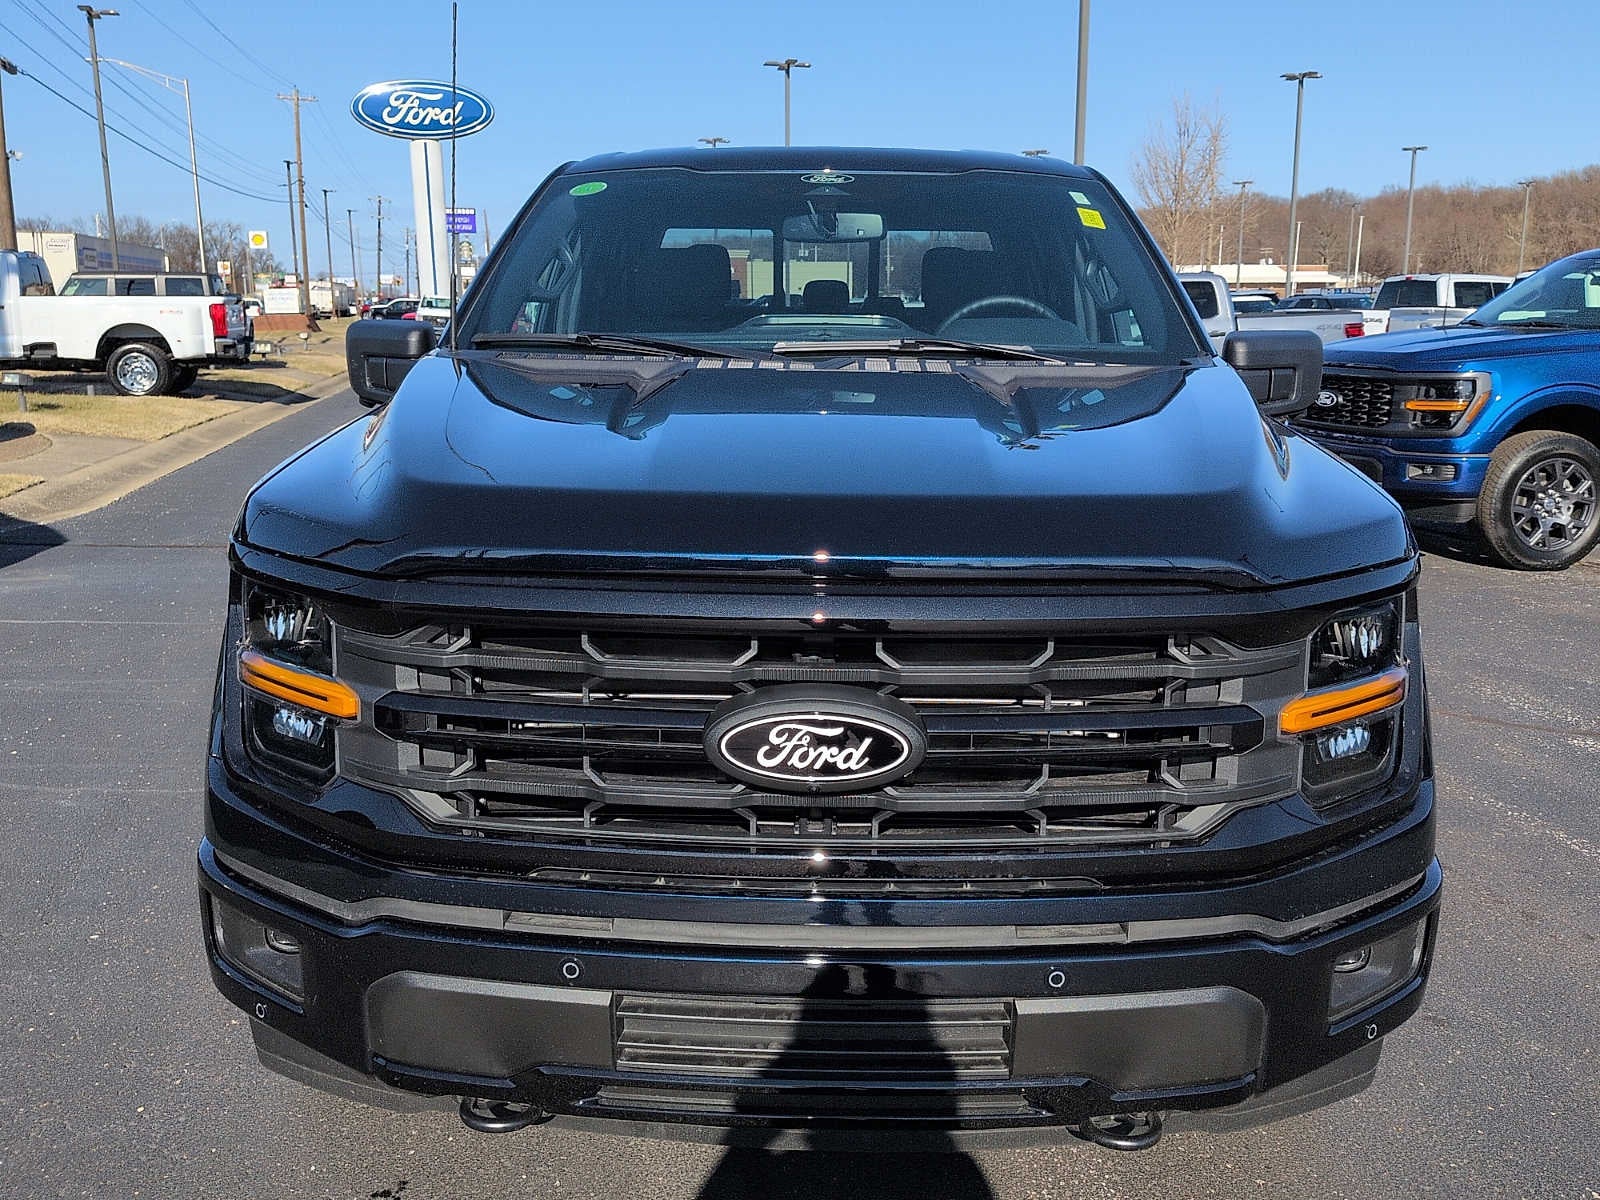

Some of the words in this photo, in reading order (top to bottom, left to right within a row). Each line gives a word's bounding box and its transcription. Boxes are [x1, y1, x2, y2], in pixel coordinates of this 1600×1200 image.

[382, 90, 464, 126] Ford
[810, 174, 845, 184] Ford
[756, 723, 873, 771] Ford
